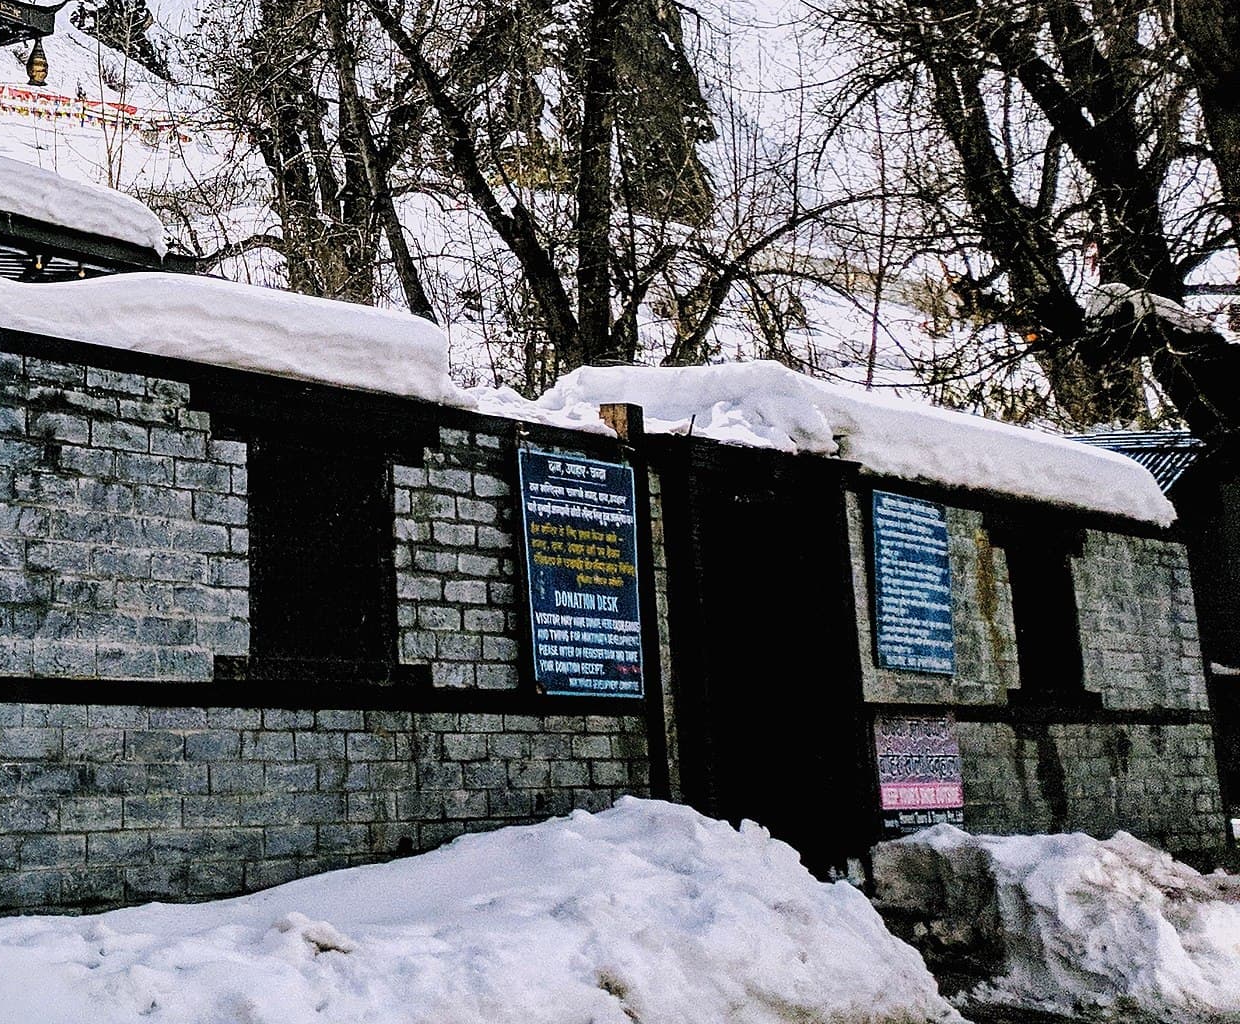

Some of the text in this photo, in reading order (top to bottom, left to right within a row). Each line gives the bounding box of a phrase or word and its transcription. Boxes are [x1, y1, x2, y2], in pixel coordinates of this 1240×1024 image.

[555, 591, 618, 612] DONATION DESK
[539, 644, 559, 657] PLEASE
[555, 661, 580, 674] DONATION
